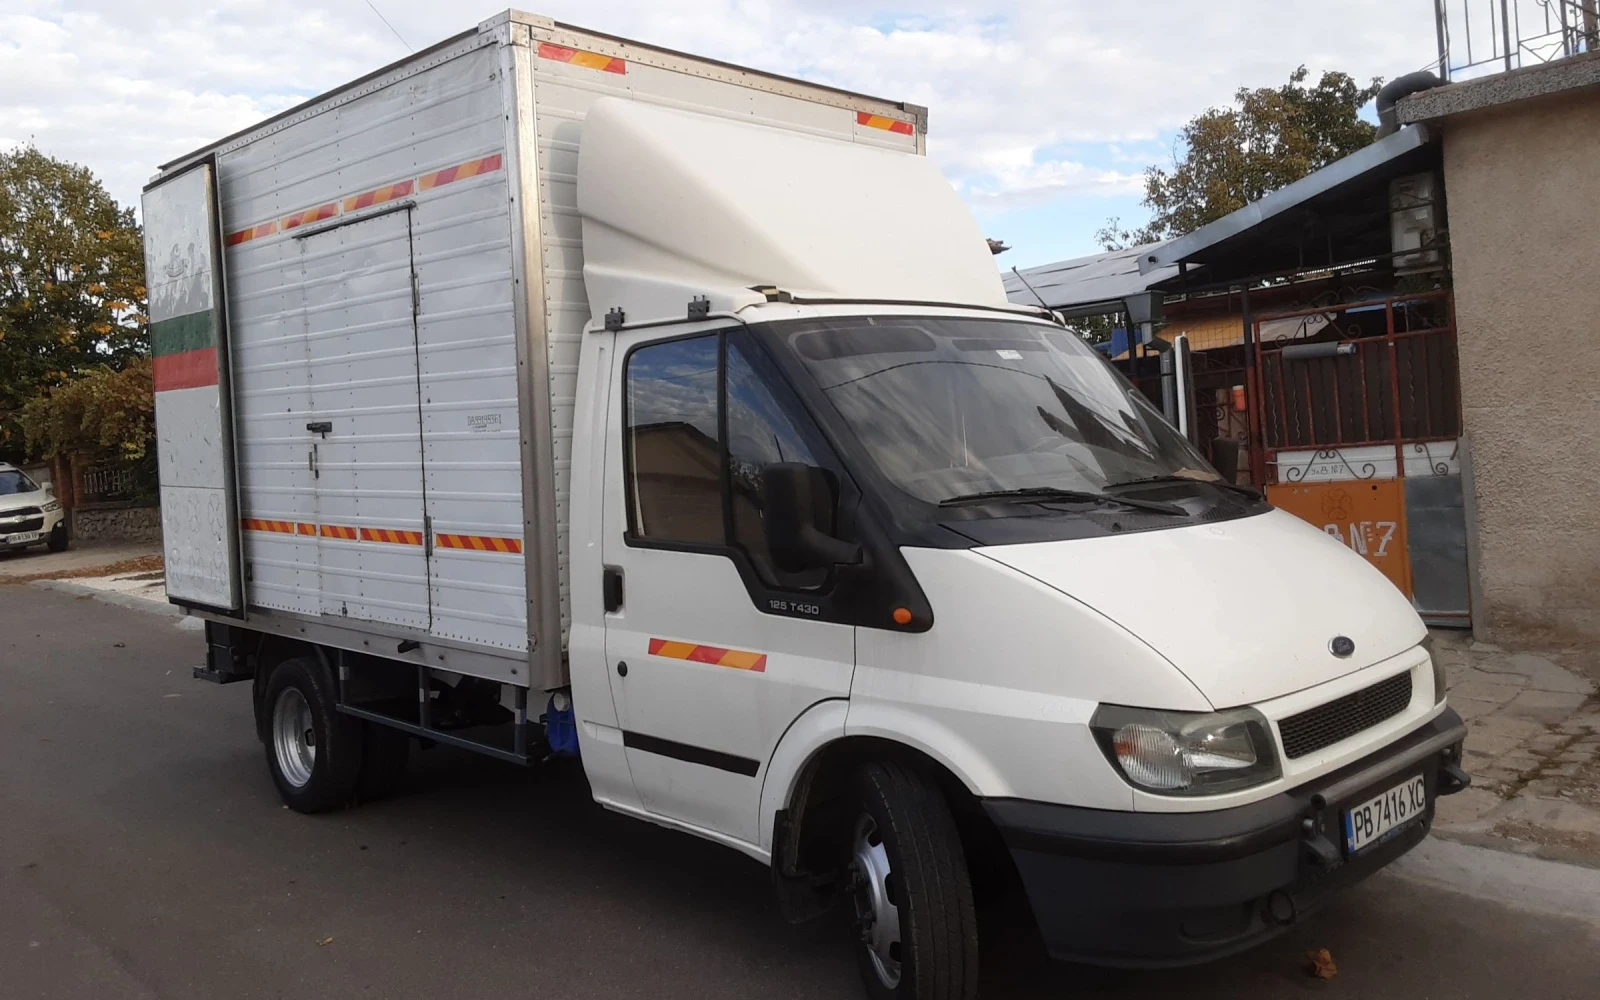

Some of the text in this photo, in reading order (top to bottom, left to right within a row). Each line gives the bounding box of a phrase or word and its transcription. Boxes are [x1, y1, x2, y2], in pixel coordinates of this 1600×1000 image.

[769, 599, 820, 615] 125 T430
[1354, 805, 1374, 844] PB
[1374, 788, 1406, 832] 7416
[1408, 778, 1425, 813] XC
